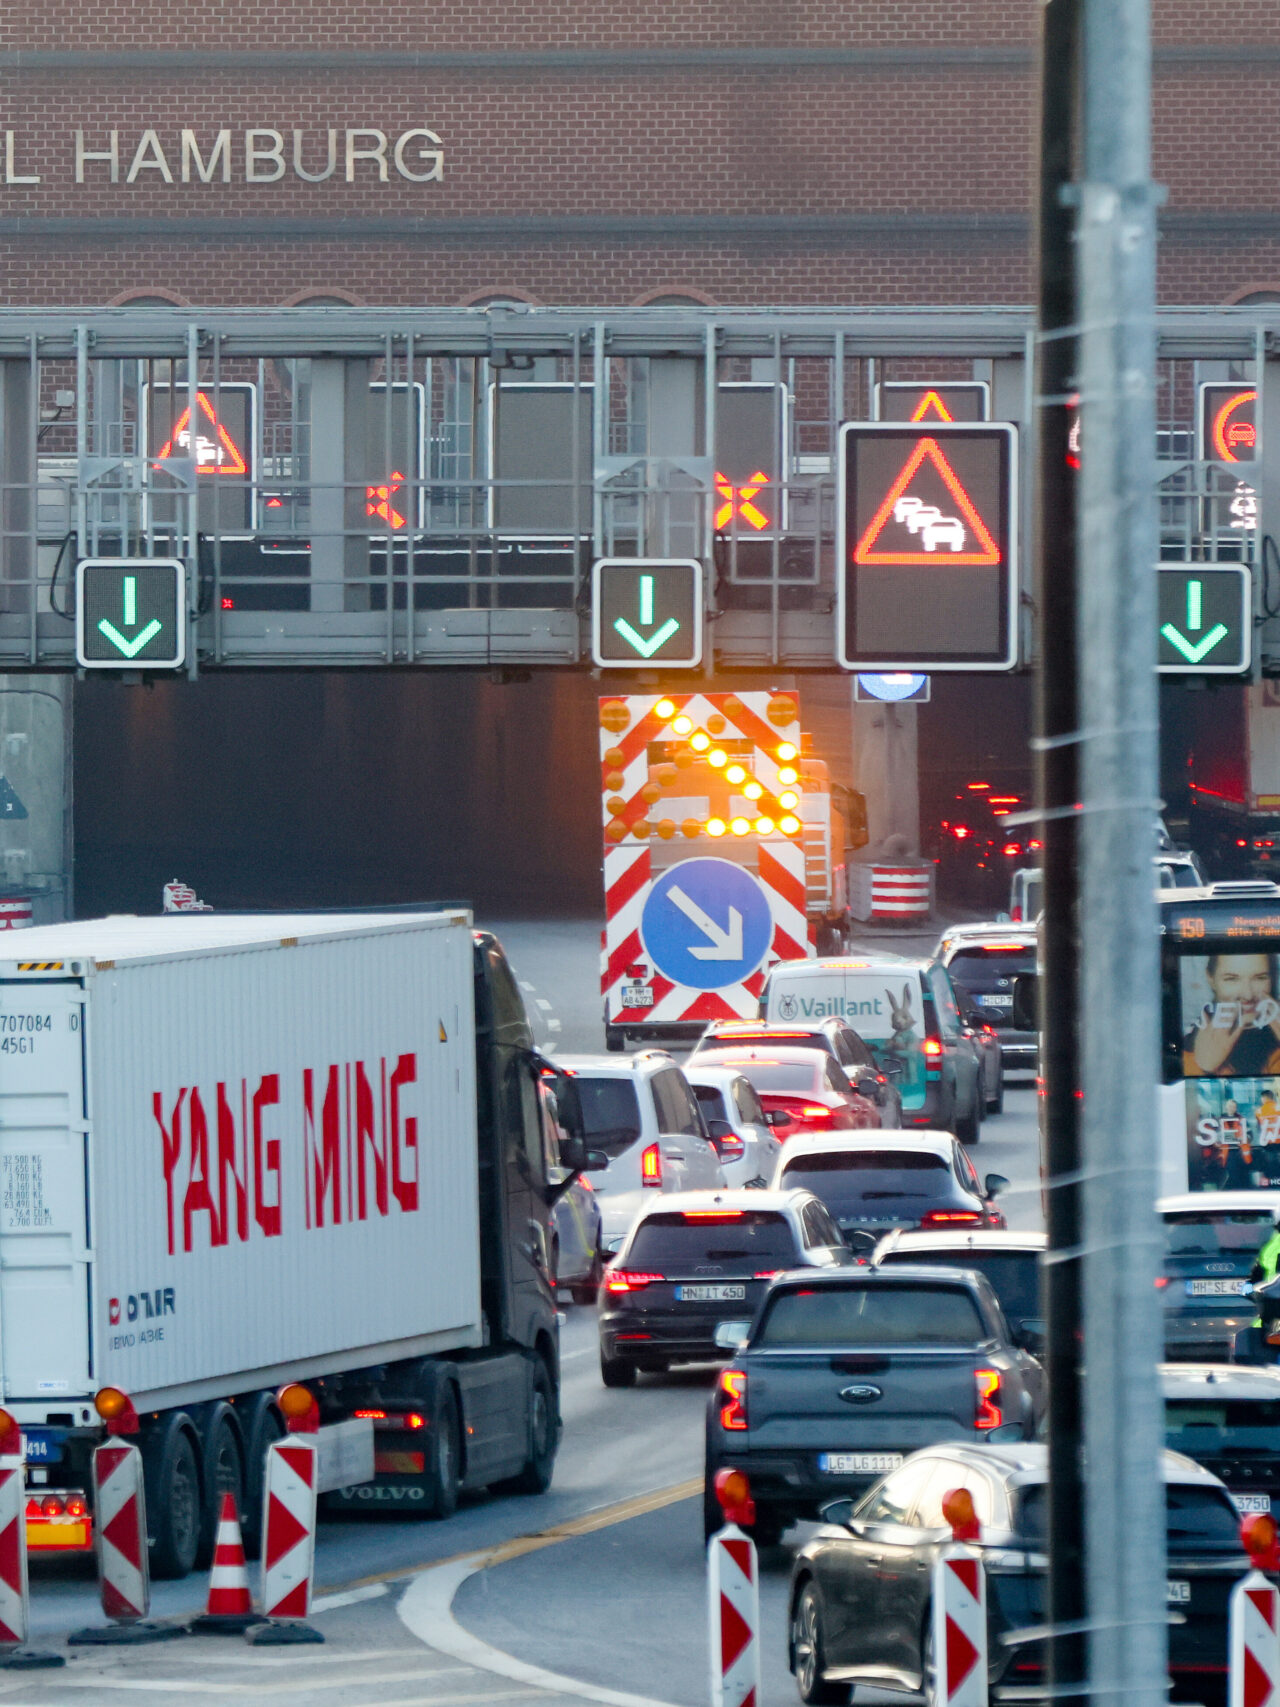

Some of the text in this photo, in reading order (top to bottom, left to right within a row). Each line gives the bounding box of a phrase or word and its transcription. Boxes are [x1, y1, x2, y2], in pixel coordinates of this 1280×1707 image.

[74, 128, 445, 184] HAMBURG
[1178, 917, 1206, 938] 150
[800, 996, 883, 1017] Vaillant
[0, 1014, 52, 1033] 707084
[1, 1036, 35, 1055] 45G1
[1194, 1117, 1248, 1148] SEI
[152, 1052, 419, 1257] YANG MING
[682, 1287, 698, 1299] HN
[722, 1287, 744, 1299] 450
[829, 1456, 845, 1470] LG
[853, 1456, 869, 1470] LG
[338, 1485, 426, 1501] VOLVO
[1236, 1496, 1270, 1510] 3750
